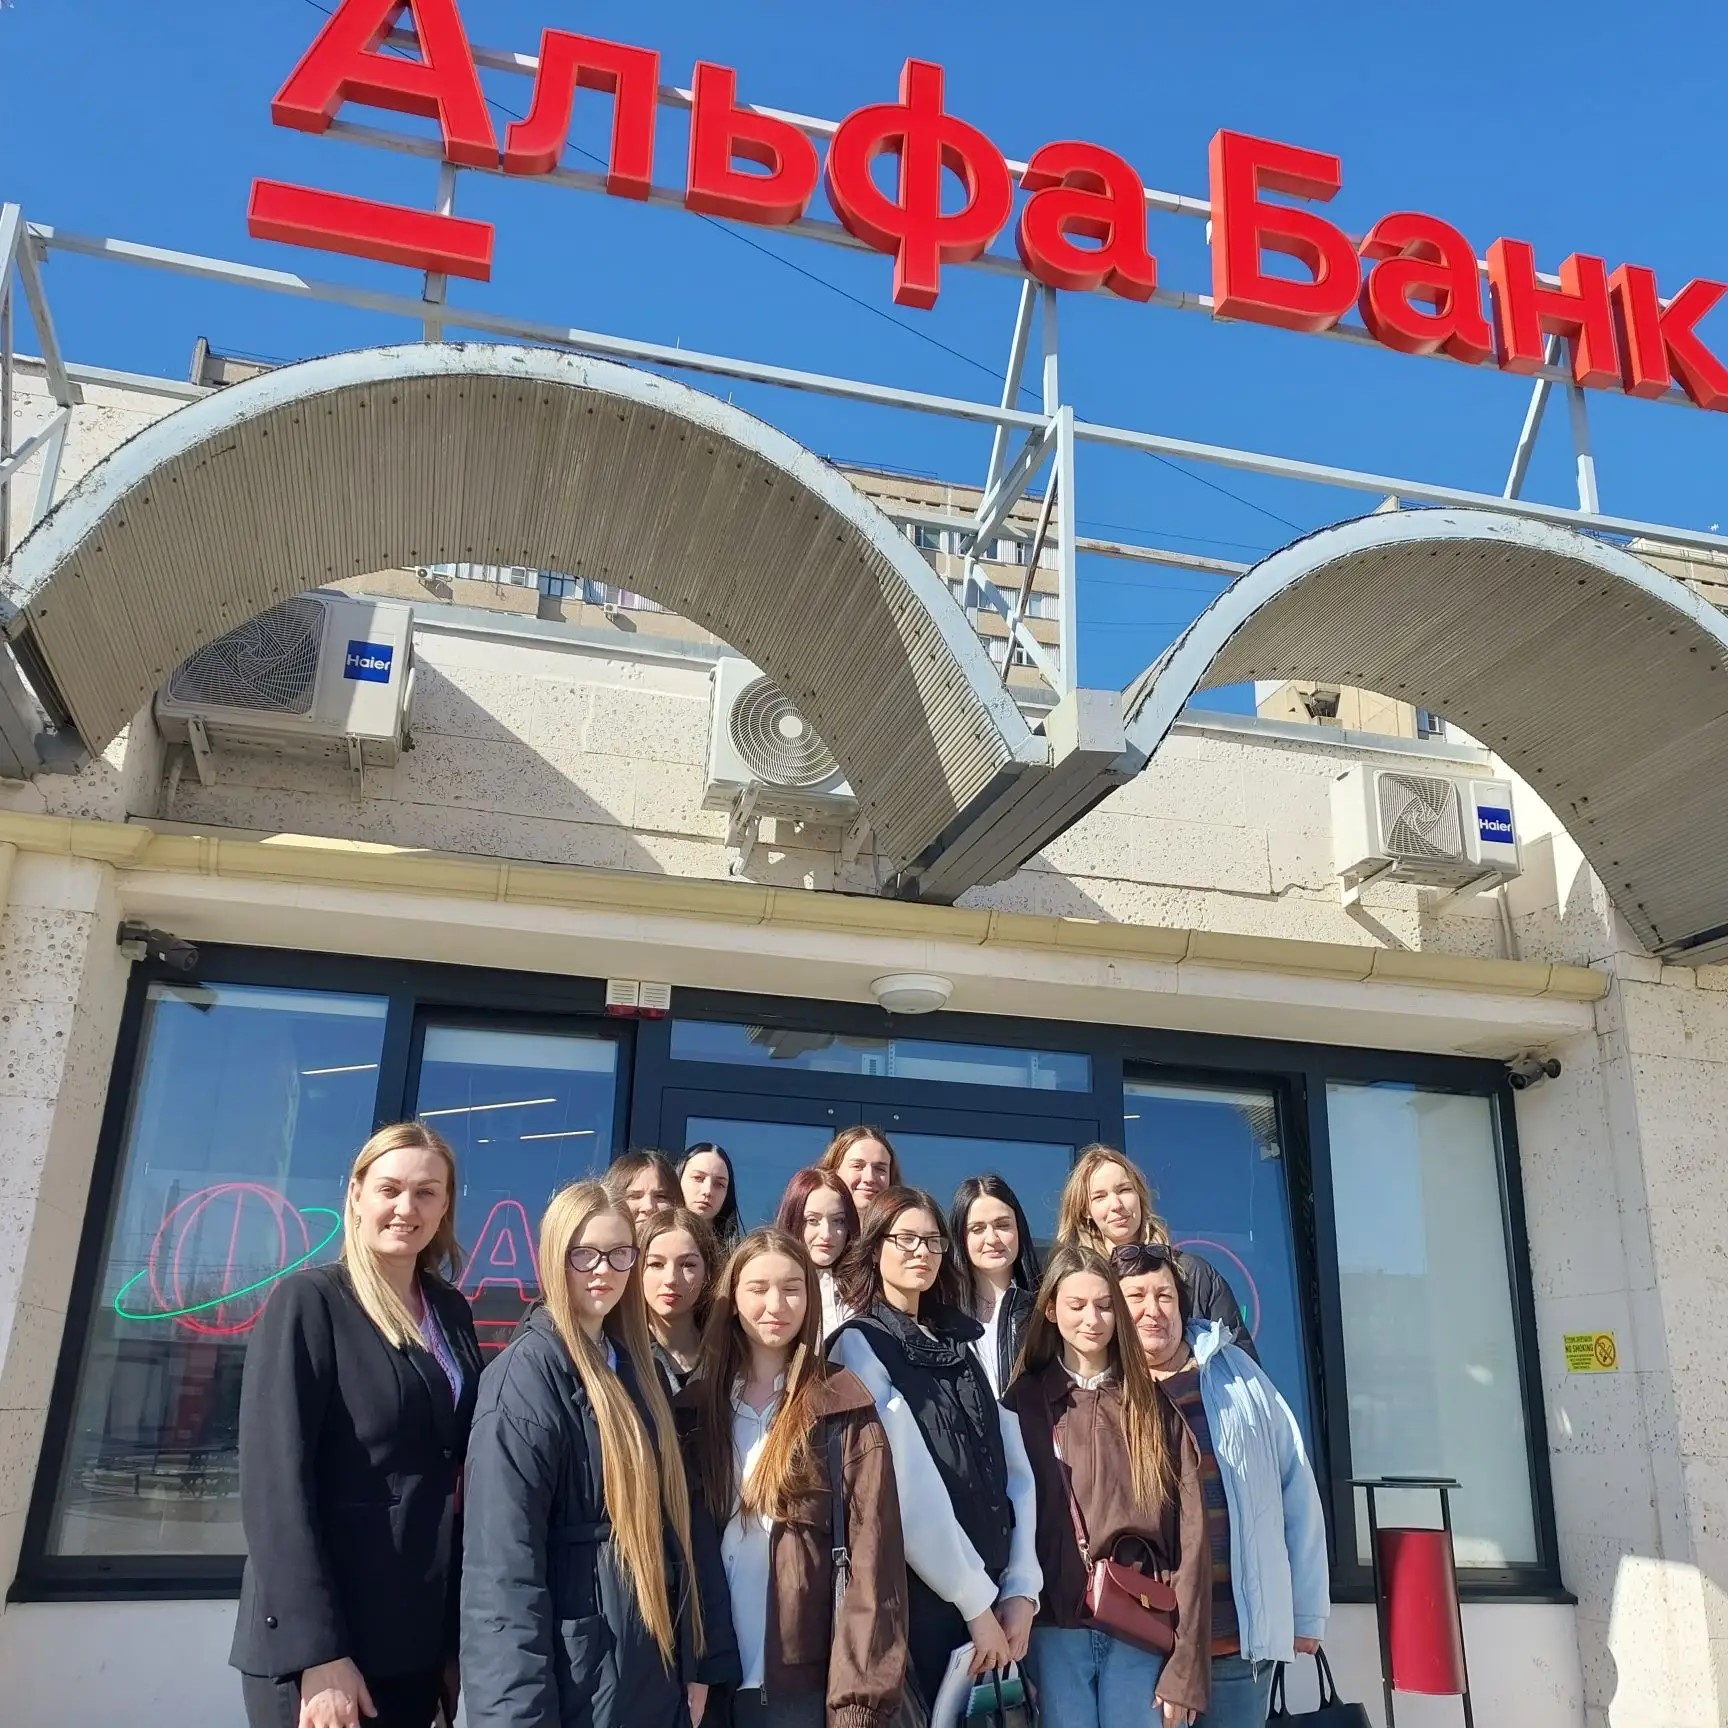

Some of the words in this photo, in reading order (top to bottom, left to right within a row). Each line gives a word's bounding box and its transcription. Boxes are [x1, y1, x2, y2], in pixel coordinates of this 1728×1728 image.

[271, 0, 1157, 310] Альфа
[1209, 128, 1728, 413] Банк
[346, 653, 391, 671] Haier
[1479, 818, 1512, 832] Haier
